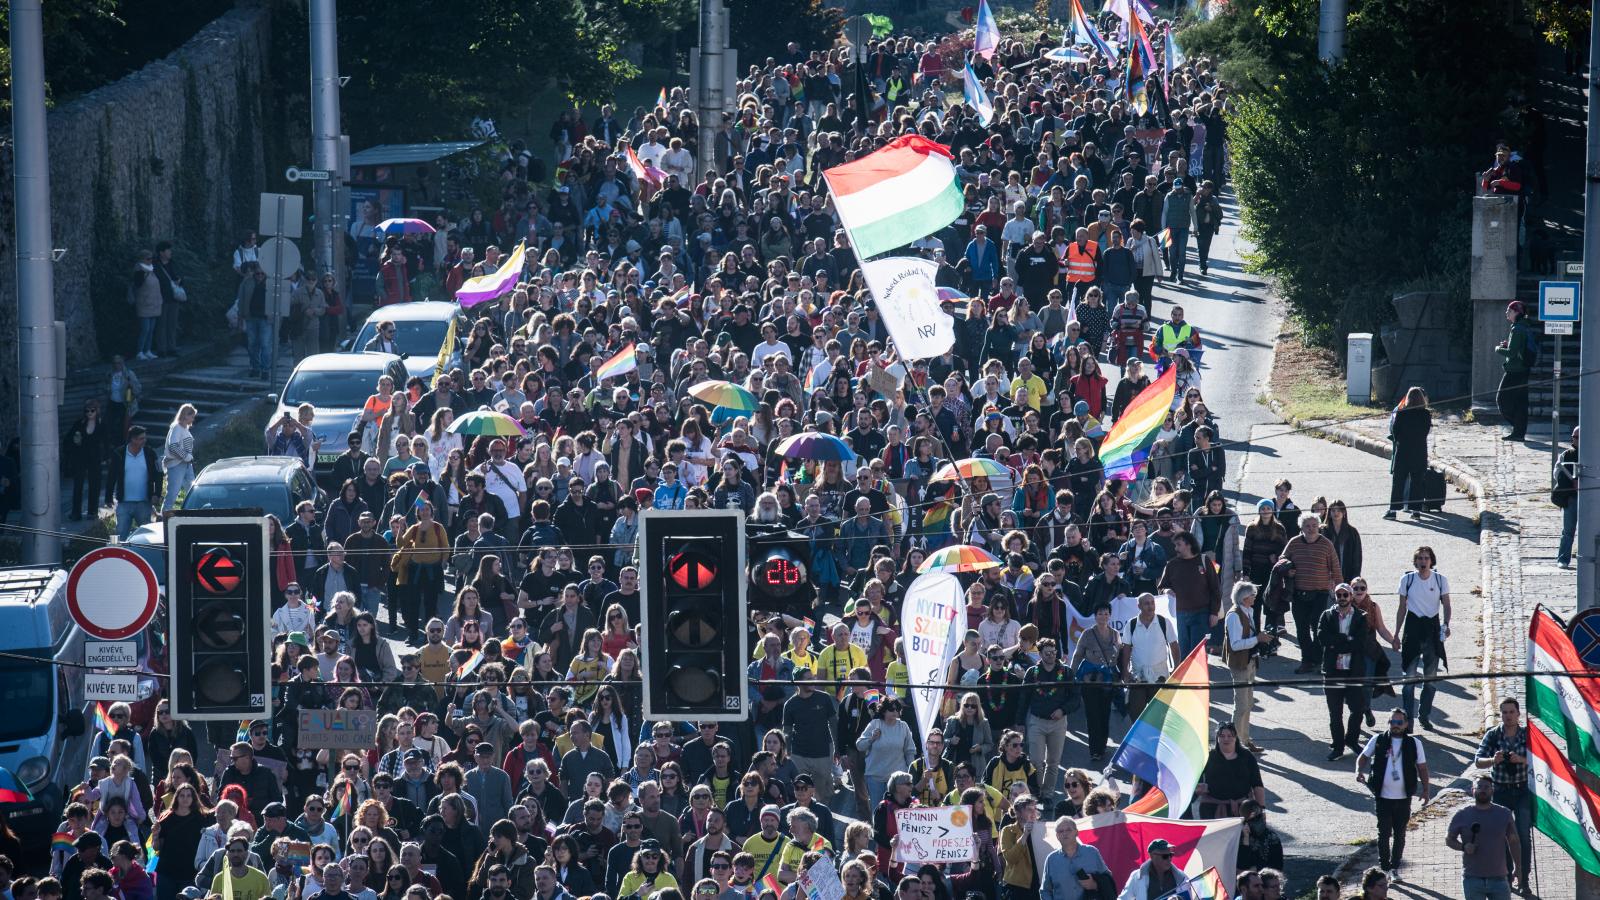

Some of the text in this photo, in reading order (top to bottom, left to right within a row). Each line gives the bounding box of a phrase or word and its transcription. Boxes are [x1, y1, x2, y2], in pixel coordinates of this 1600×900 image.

[767, 558, 799, 584] 26
[916, 598, 958, 622] NYITO
[914, 616, 948, 638] SZAB
[99, 645, 123, 653] KIVÉVE
[86, 681, 135, 694] KIVÉVE TAXI
[251, 696, 263, 706] 24
[726, 697, 739, 707] 23
